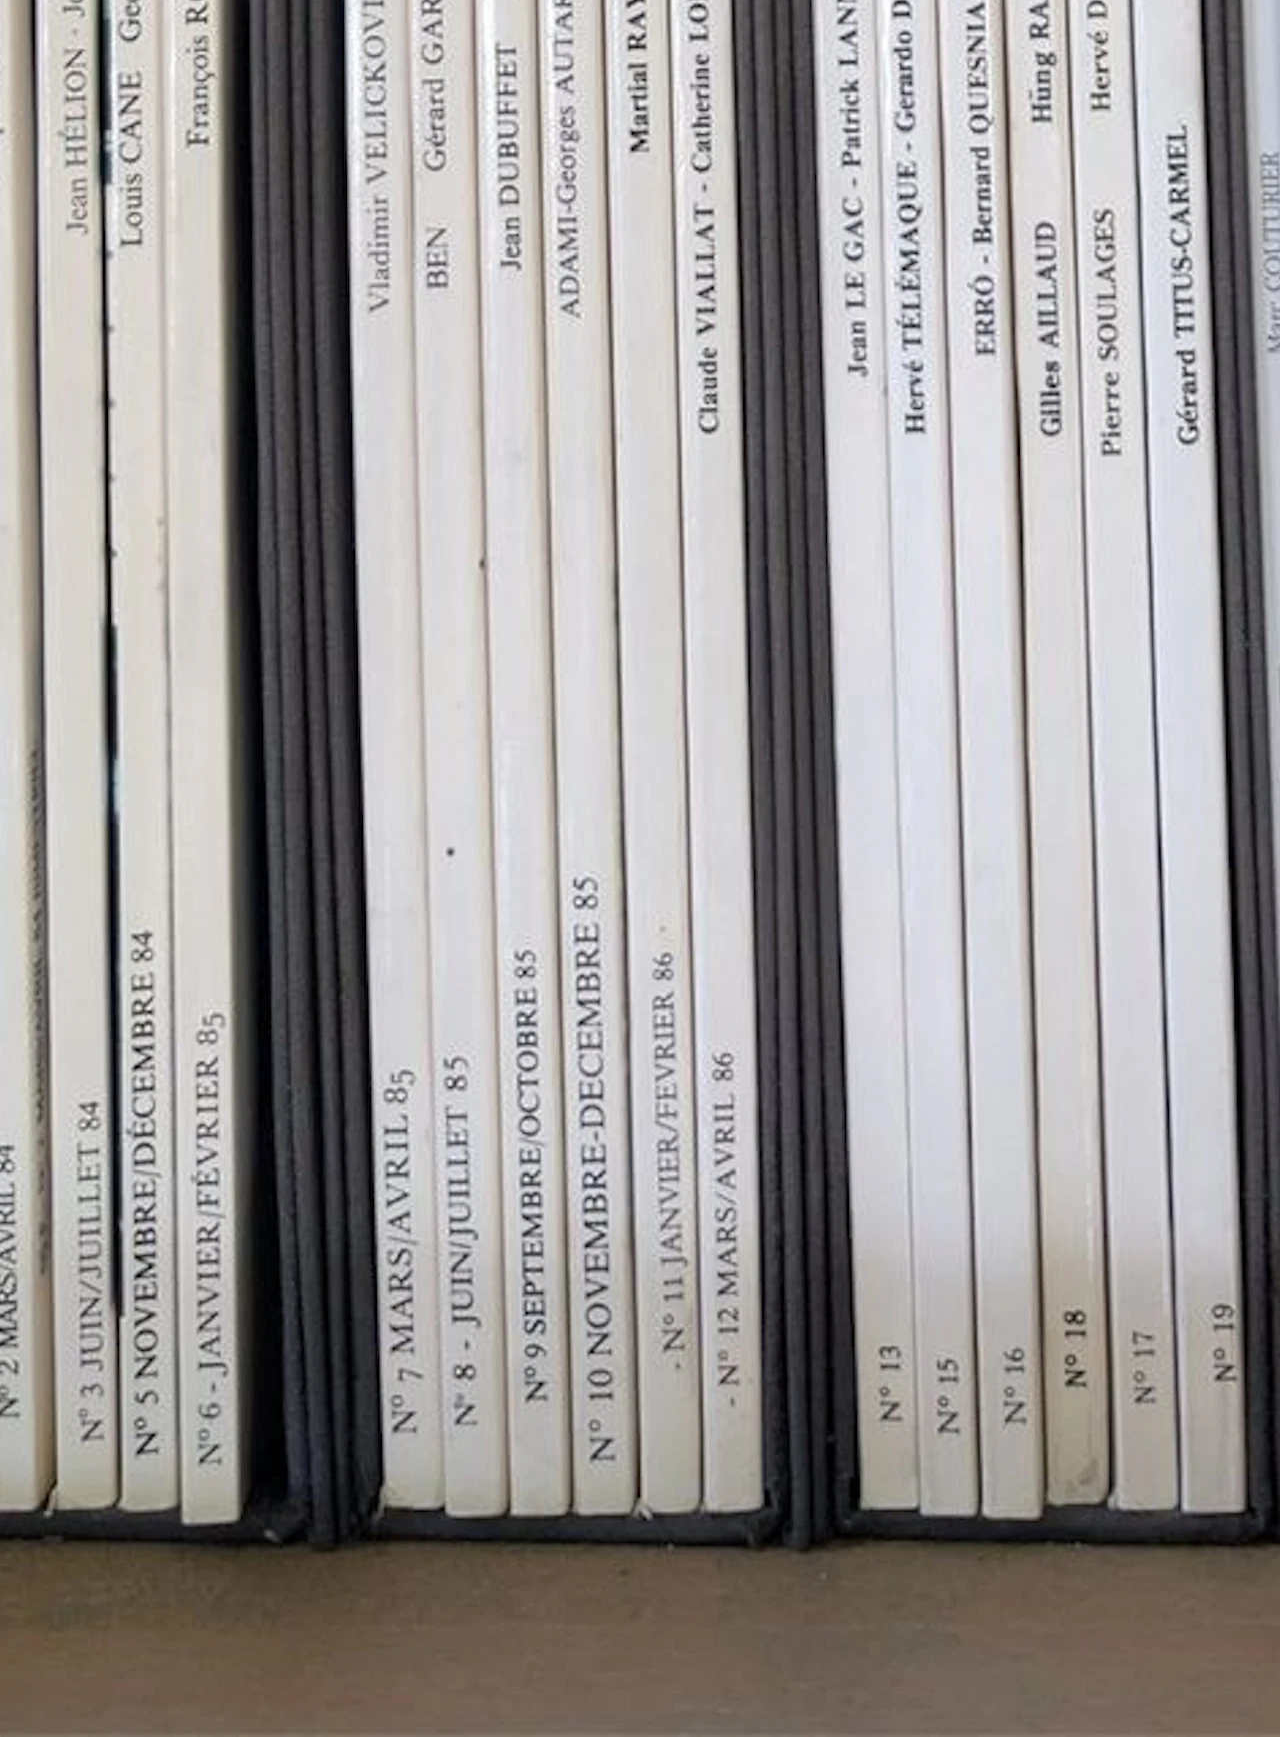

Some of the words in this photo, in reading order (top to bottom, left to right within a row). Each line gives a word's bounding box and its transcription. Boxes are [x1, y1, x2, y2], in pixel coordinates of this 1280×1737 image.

[57, 47, 88, 167] HÉLION
[185, 34, 215, 146] François
[689, 53, 712, 174] Catherine
[892, 29, 915, 133] Gerardo
[1086, 30, 1111, 111] Hervé
[64, 177, 88, 234] Jean
[693, 207, 716, 335] VIALLAT
[894, 161, 923, 351] TÉLÉMAQUE
[1093, 207, 1118, 361] SOULAGES
[697, 346, 719, 434] Claude
[902, 359, 925, 433] Hervé
[1100, 371, 1122, 456] Pierre
[130, 930, 153, 963] 84
[513, 949, 536, 979] 85
[514, 987, 546, 1335] SEPTEMBRE/OCTOBRE
[523, 1342, 547, 1359] 9
[1003, 1346, 1025, 1373] 16
[133, 1389, 159, 1404] 5
